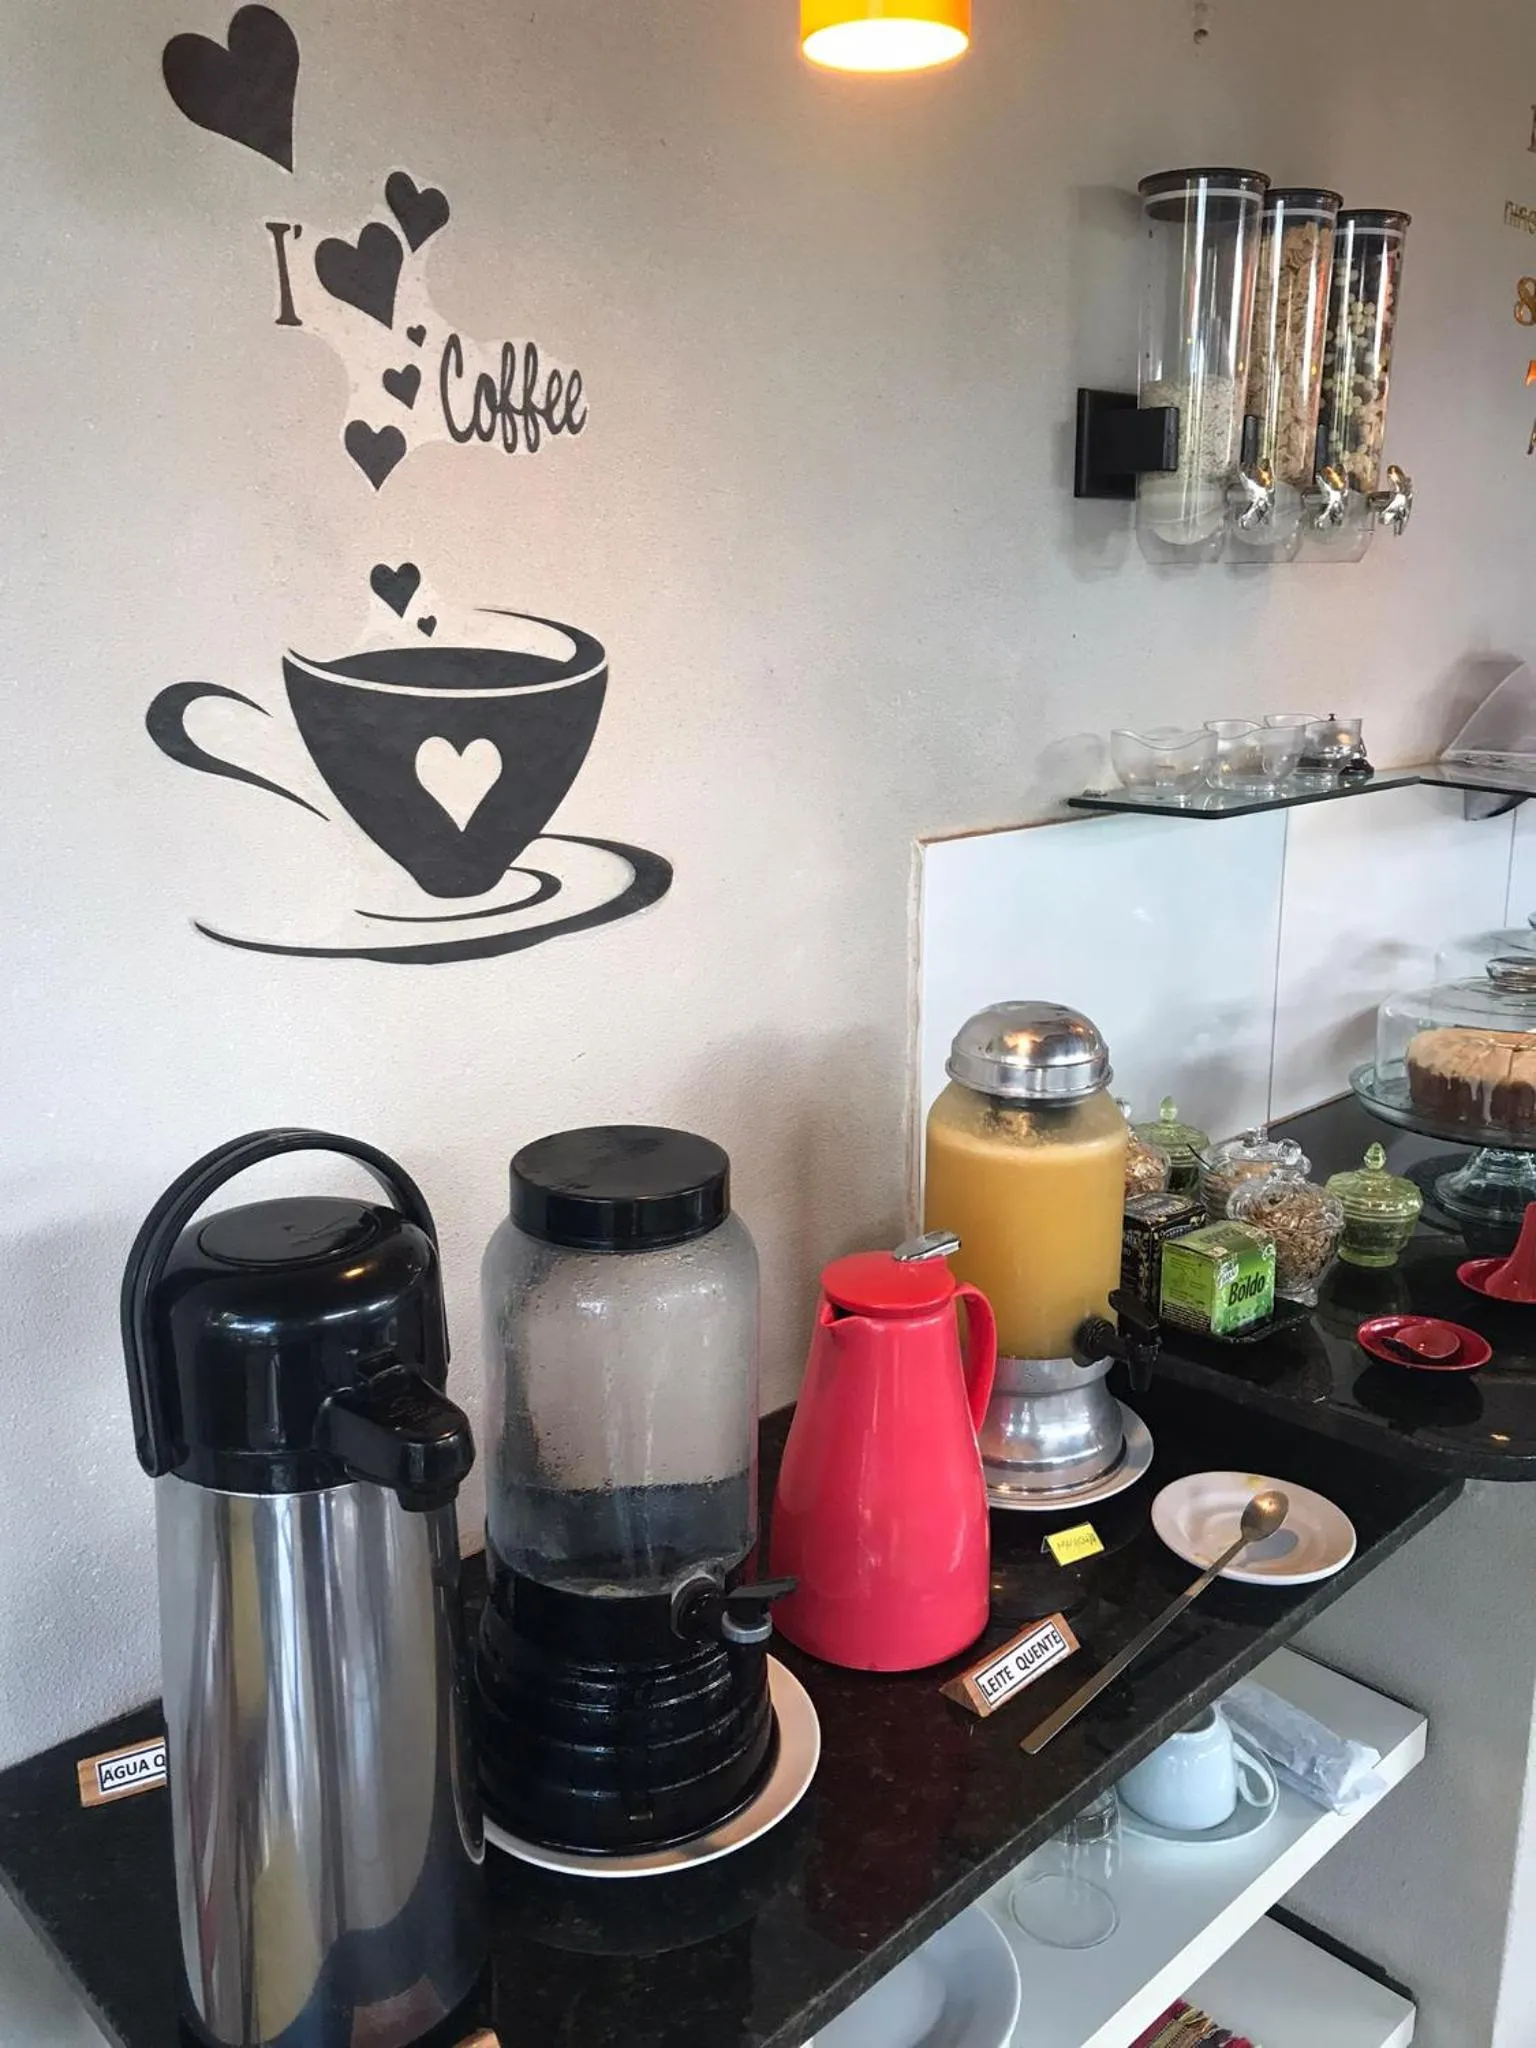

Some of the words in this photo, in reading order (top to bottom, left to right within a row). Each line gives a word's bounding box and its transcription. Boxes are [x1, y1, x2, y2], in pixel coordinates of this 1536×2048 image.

[440, 333, 587, 453] Coffee
[1228, 1271, 1265, 1307] Boldo
[982, 1665, 1014, 1697] LEITE
[1015, 1629, 1063, 1671] QUENTE
[103, 1759, 150, 1784] AGUA
